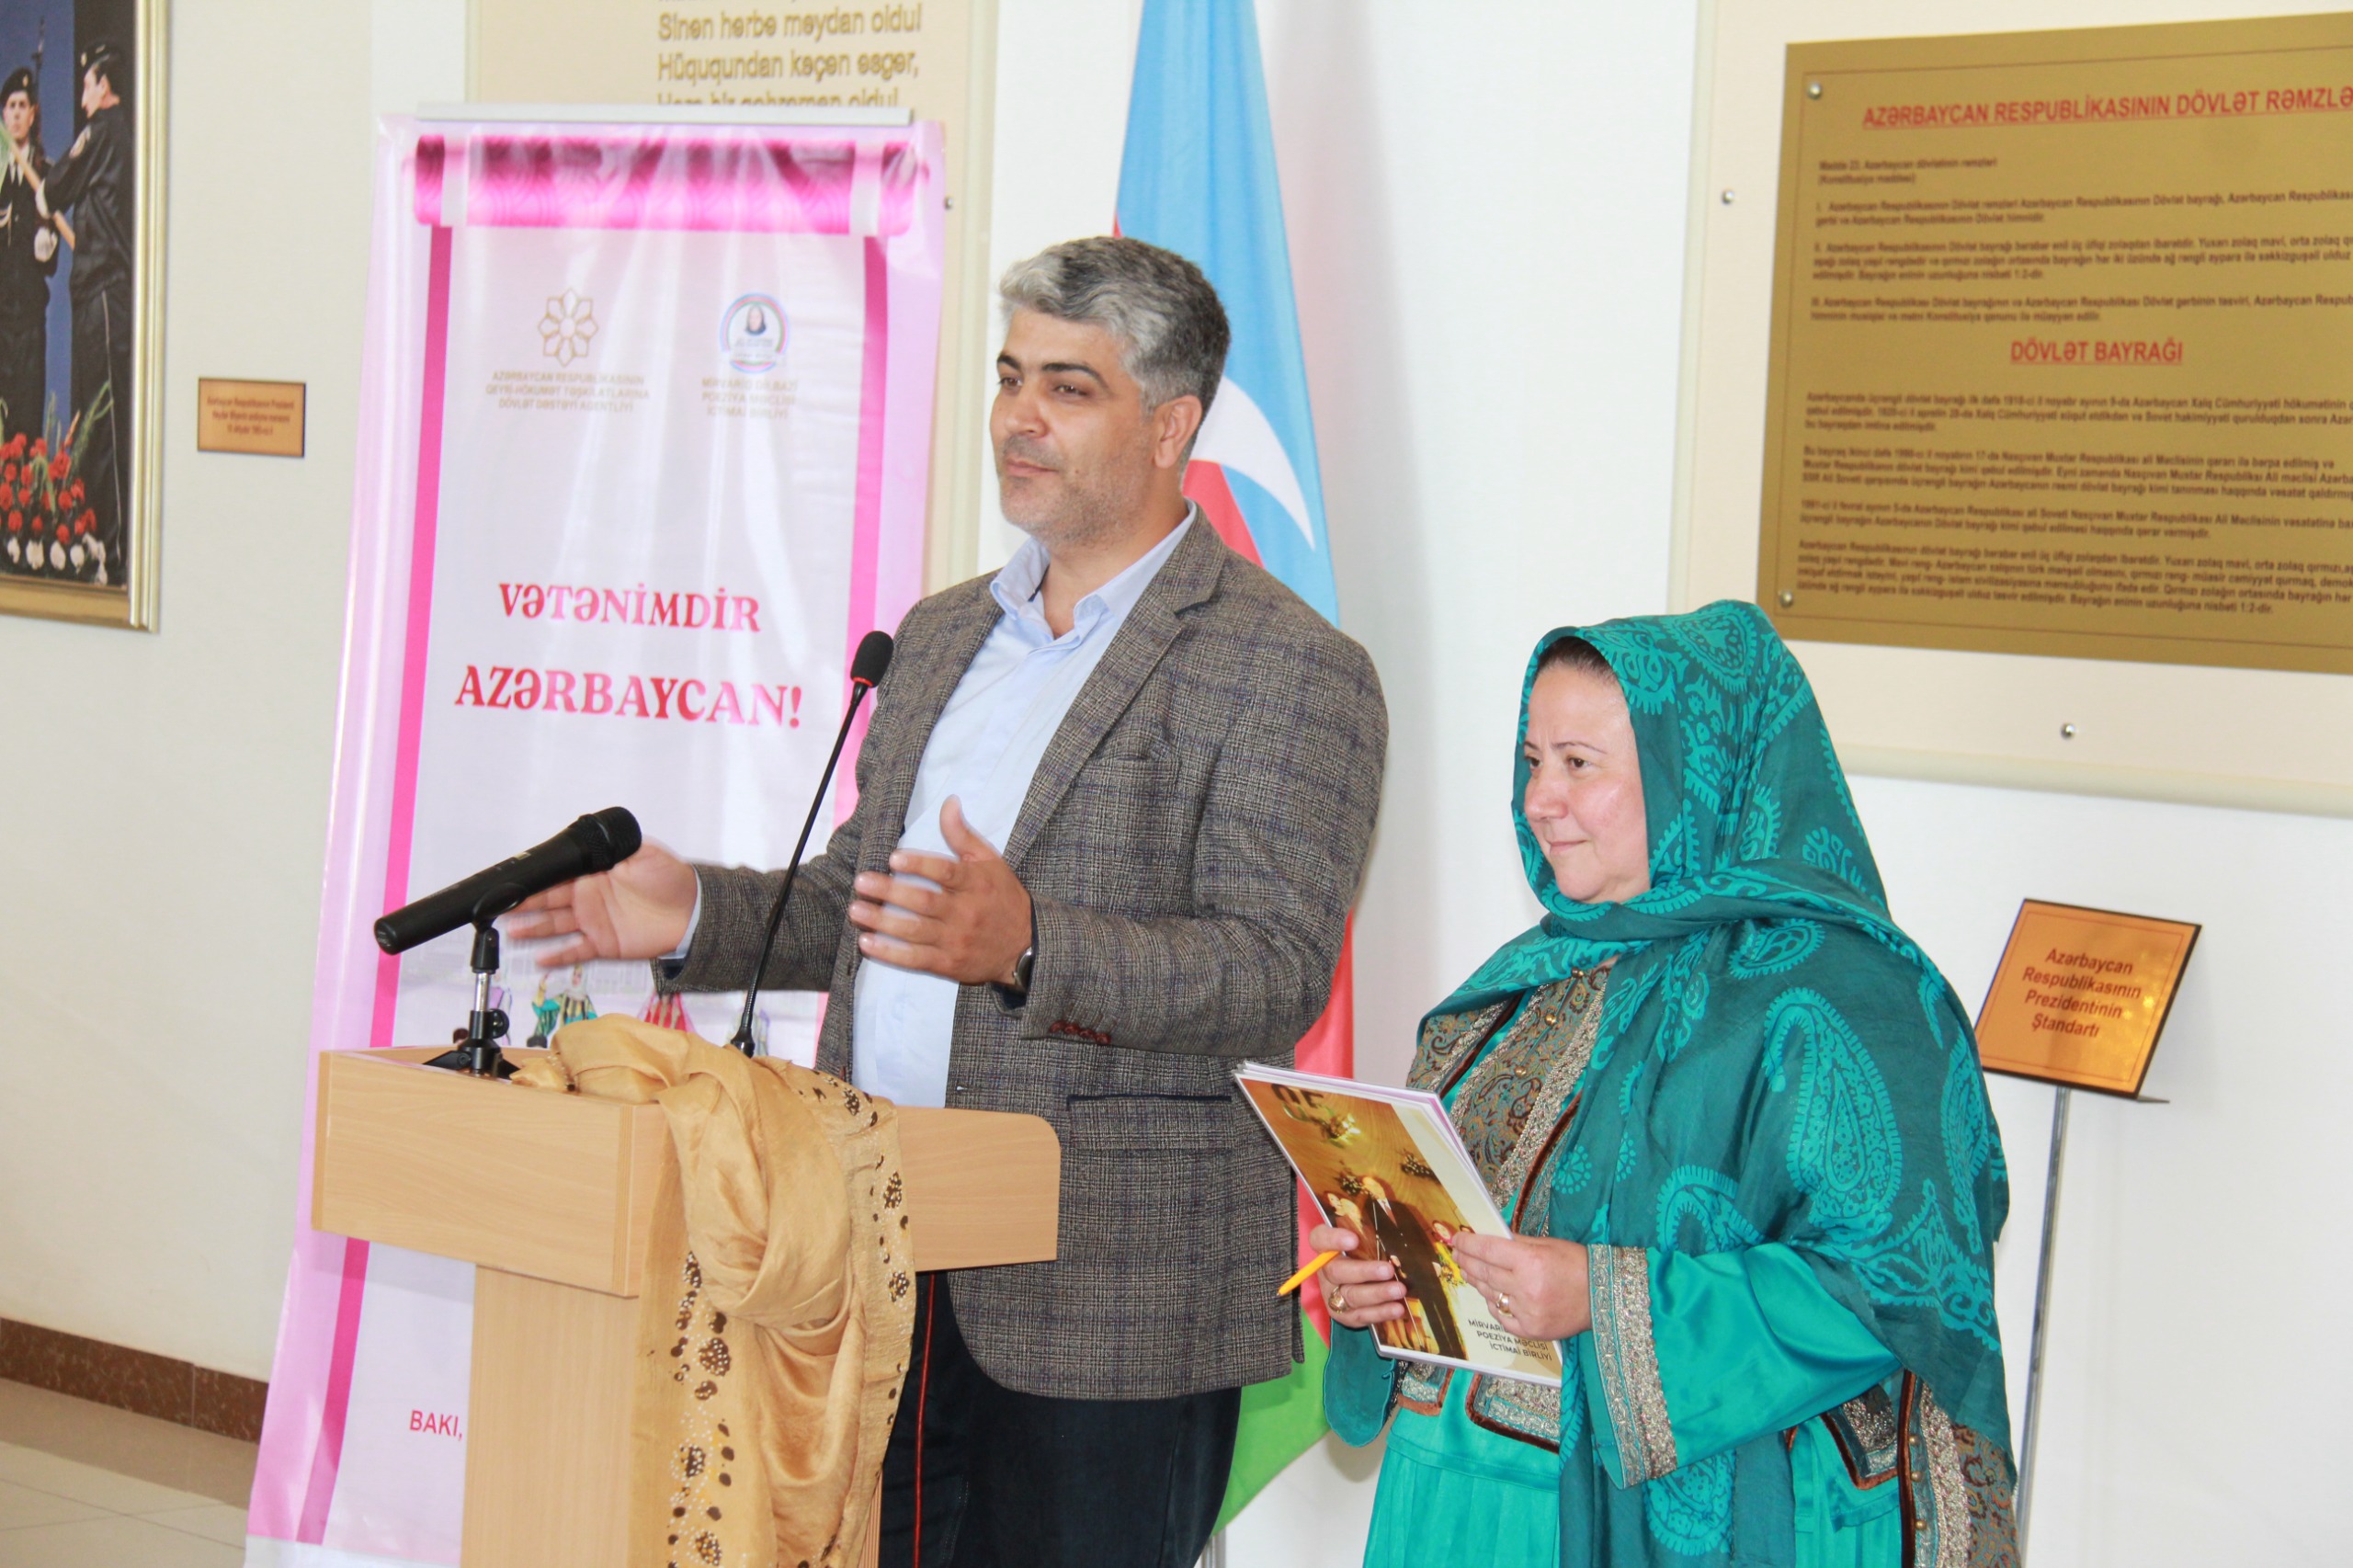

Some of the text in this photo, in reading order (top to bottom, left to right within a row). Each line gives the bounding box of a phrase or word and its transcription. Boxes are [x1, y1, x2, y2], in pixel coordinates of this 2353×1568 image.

[1863, 85, 2353, 127] AZƏRBAYCAN RESPUBLİKASININ DÖVLƏT RƏMZLƏ
[2010, 336, 2184, 363] DÖVLƏT BAYRAĞI
[498, 583, 761, 633] VƏTƏNİMDİR
[454, 665, 802, 729] AZƏRBAYCAN!
[2044, 948, 2134, 976] Azərbaycan
[2022, 966, 2143, 1000] Respublikasının
[2024, 989, 2123, 1020] Prezidentinin
[2031, 1012, 2101, 1039] Ştandartı
[1468, 1319, 1505, 1332] MİRVARİ
[1476, 1330, 1512, 1343] POEZİYA
[409, 1409, 462, 1442] BAKI,
